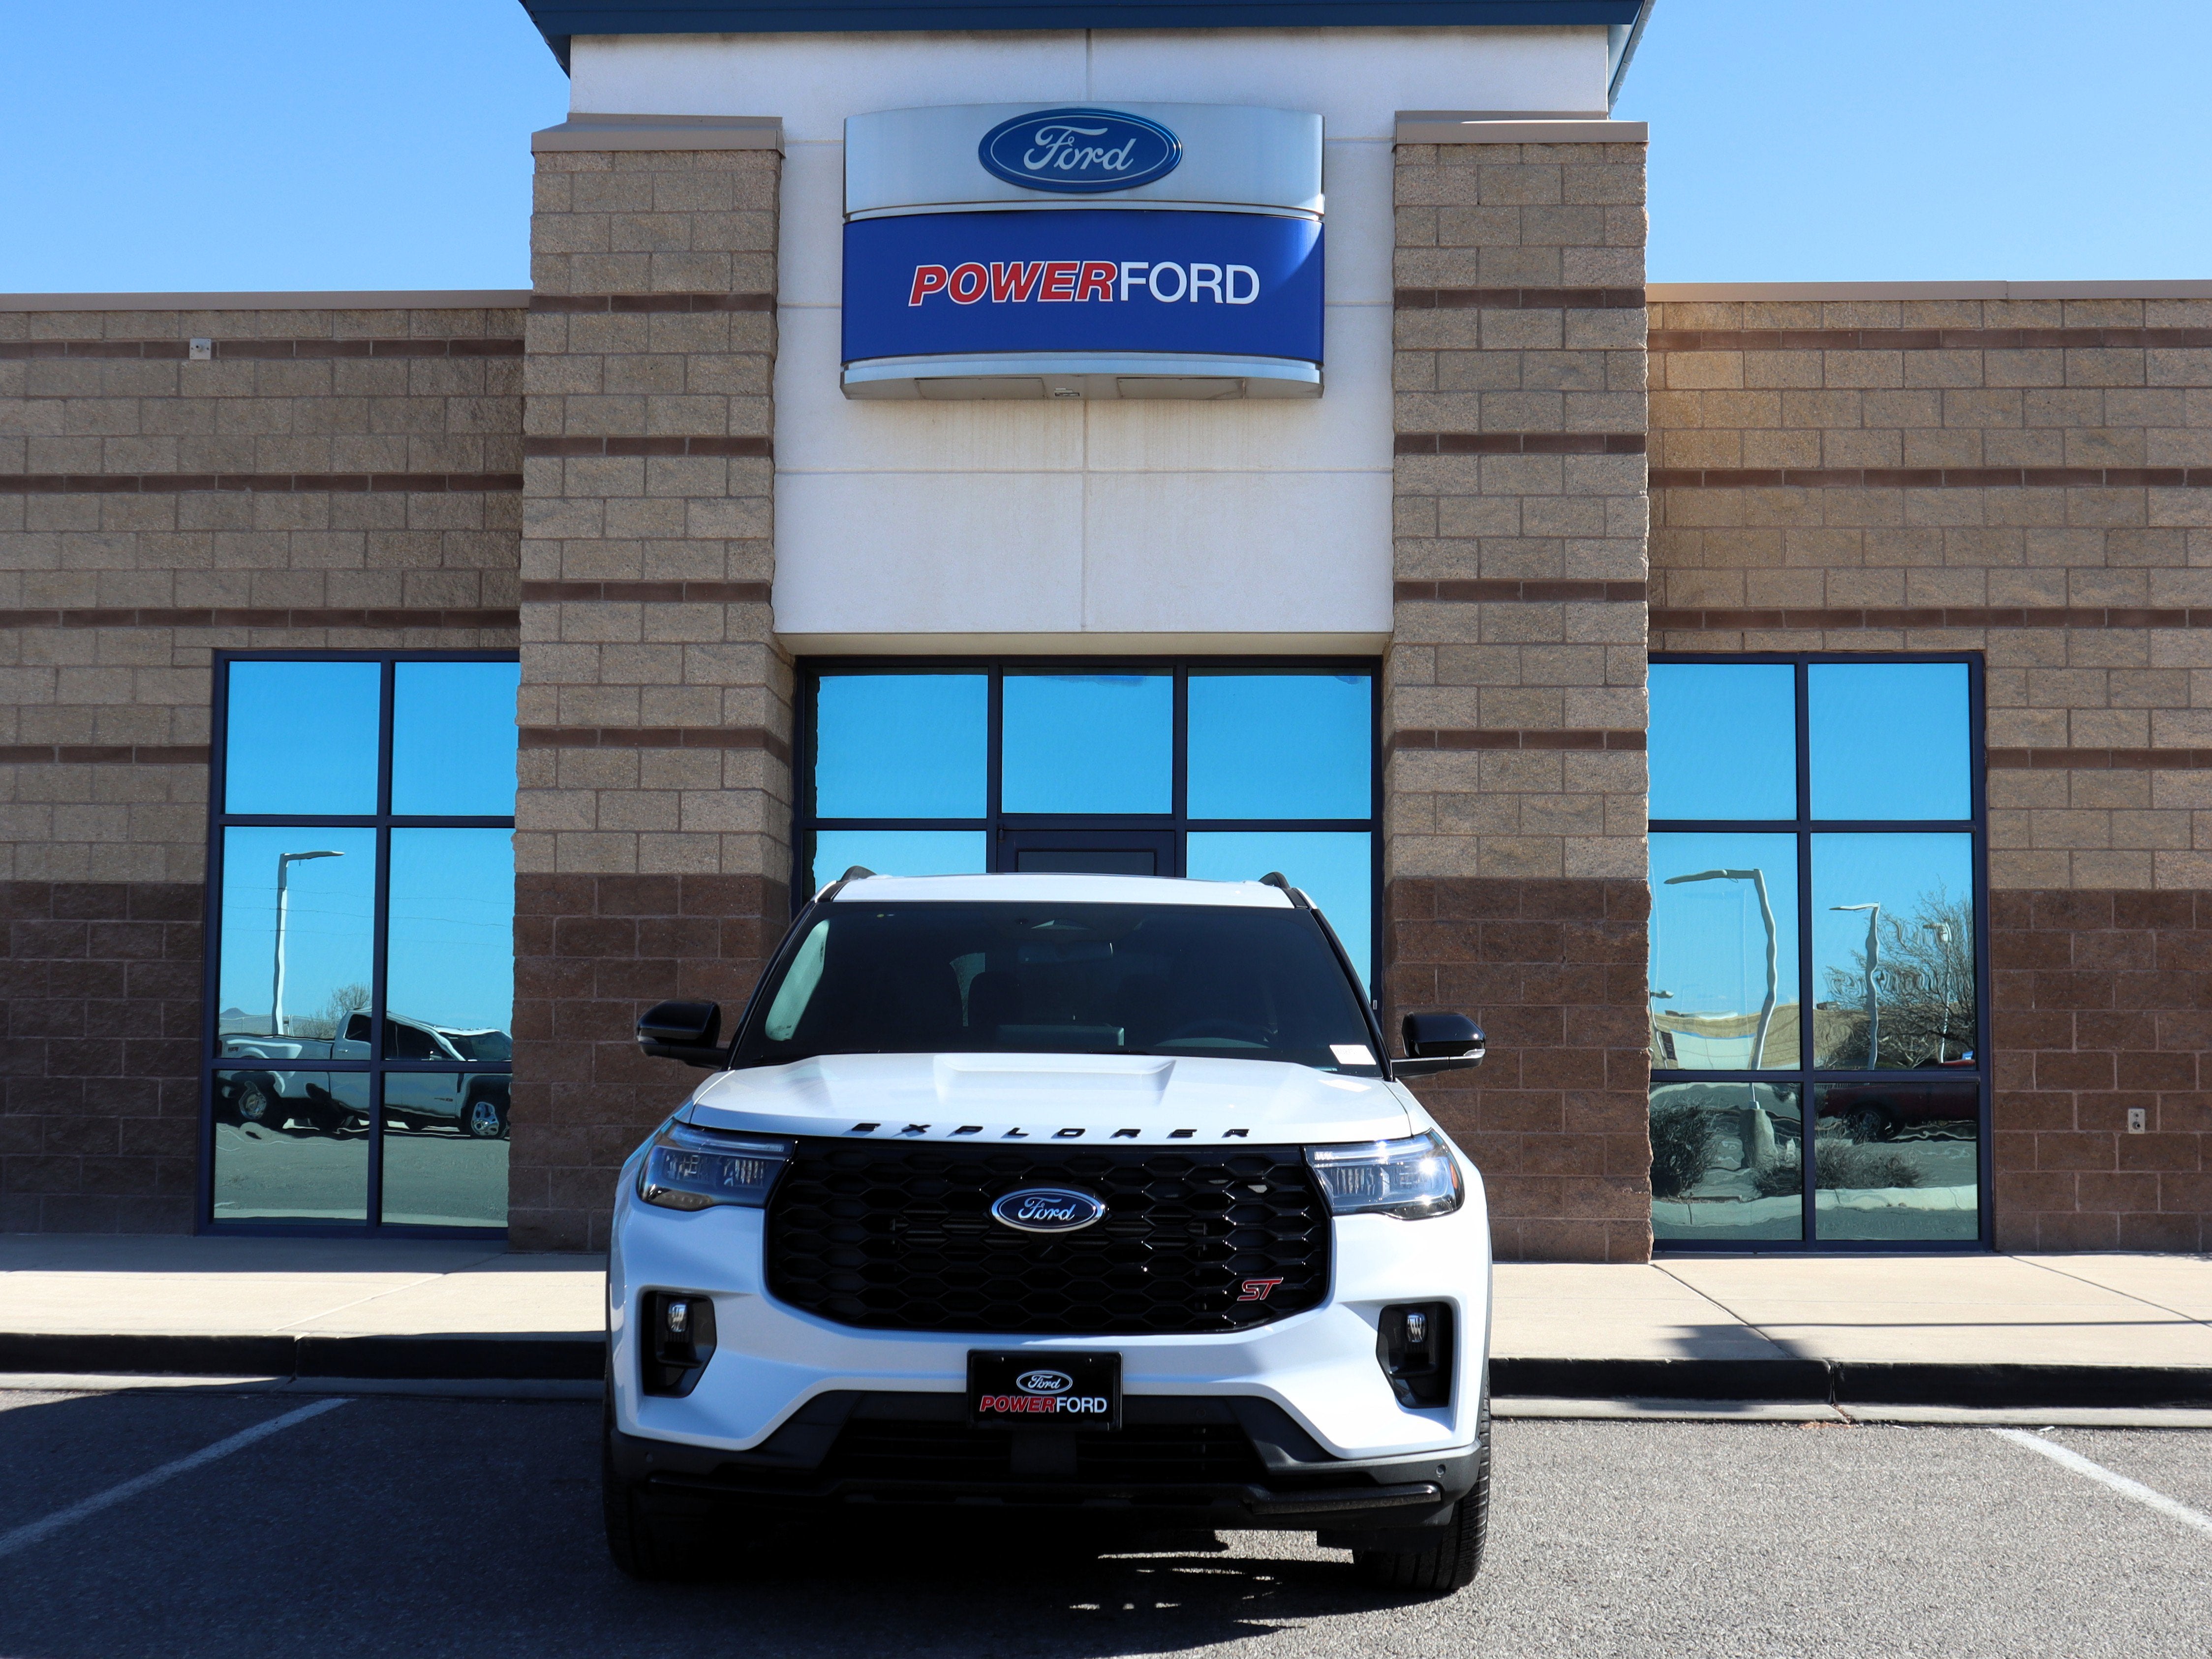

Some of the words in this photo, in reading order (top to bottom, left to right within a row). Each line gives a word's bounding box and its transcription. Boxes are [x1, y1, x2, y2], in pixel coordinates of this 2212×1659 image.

[1023, 124, 1137, 171] Ford
[908, 261, 1260, 307] POWERFORD
[851, 1122, 1250, 1138] EXPLORER
[1017, 1198, 1076, 1221] Ford
[1236, 1277, 1284, 1302] ST
[1028, 1375, 1061, 1389] Ford
[979, 1395, 1107, 1413] POWERFORD
